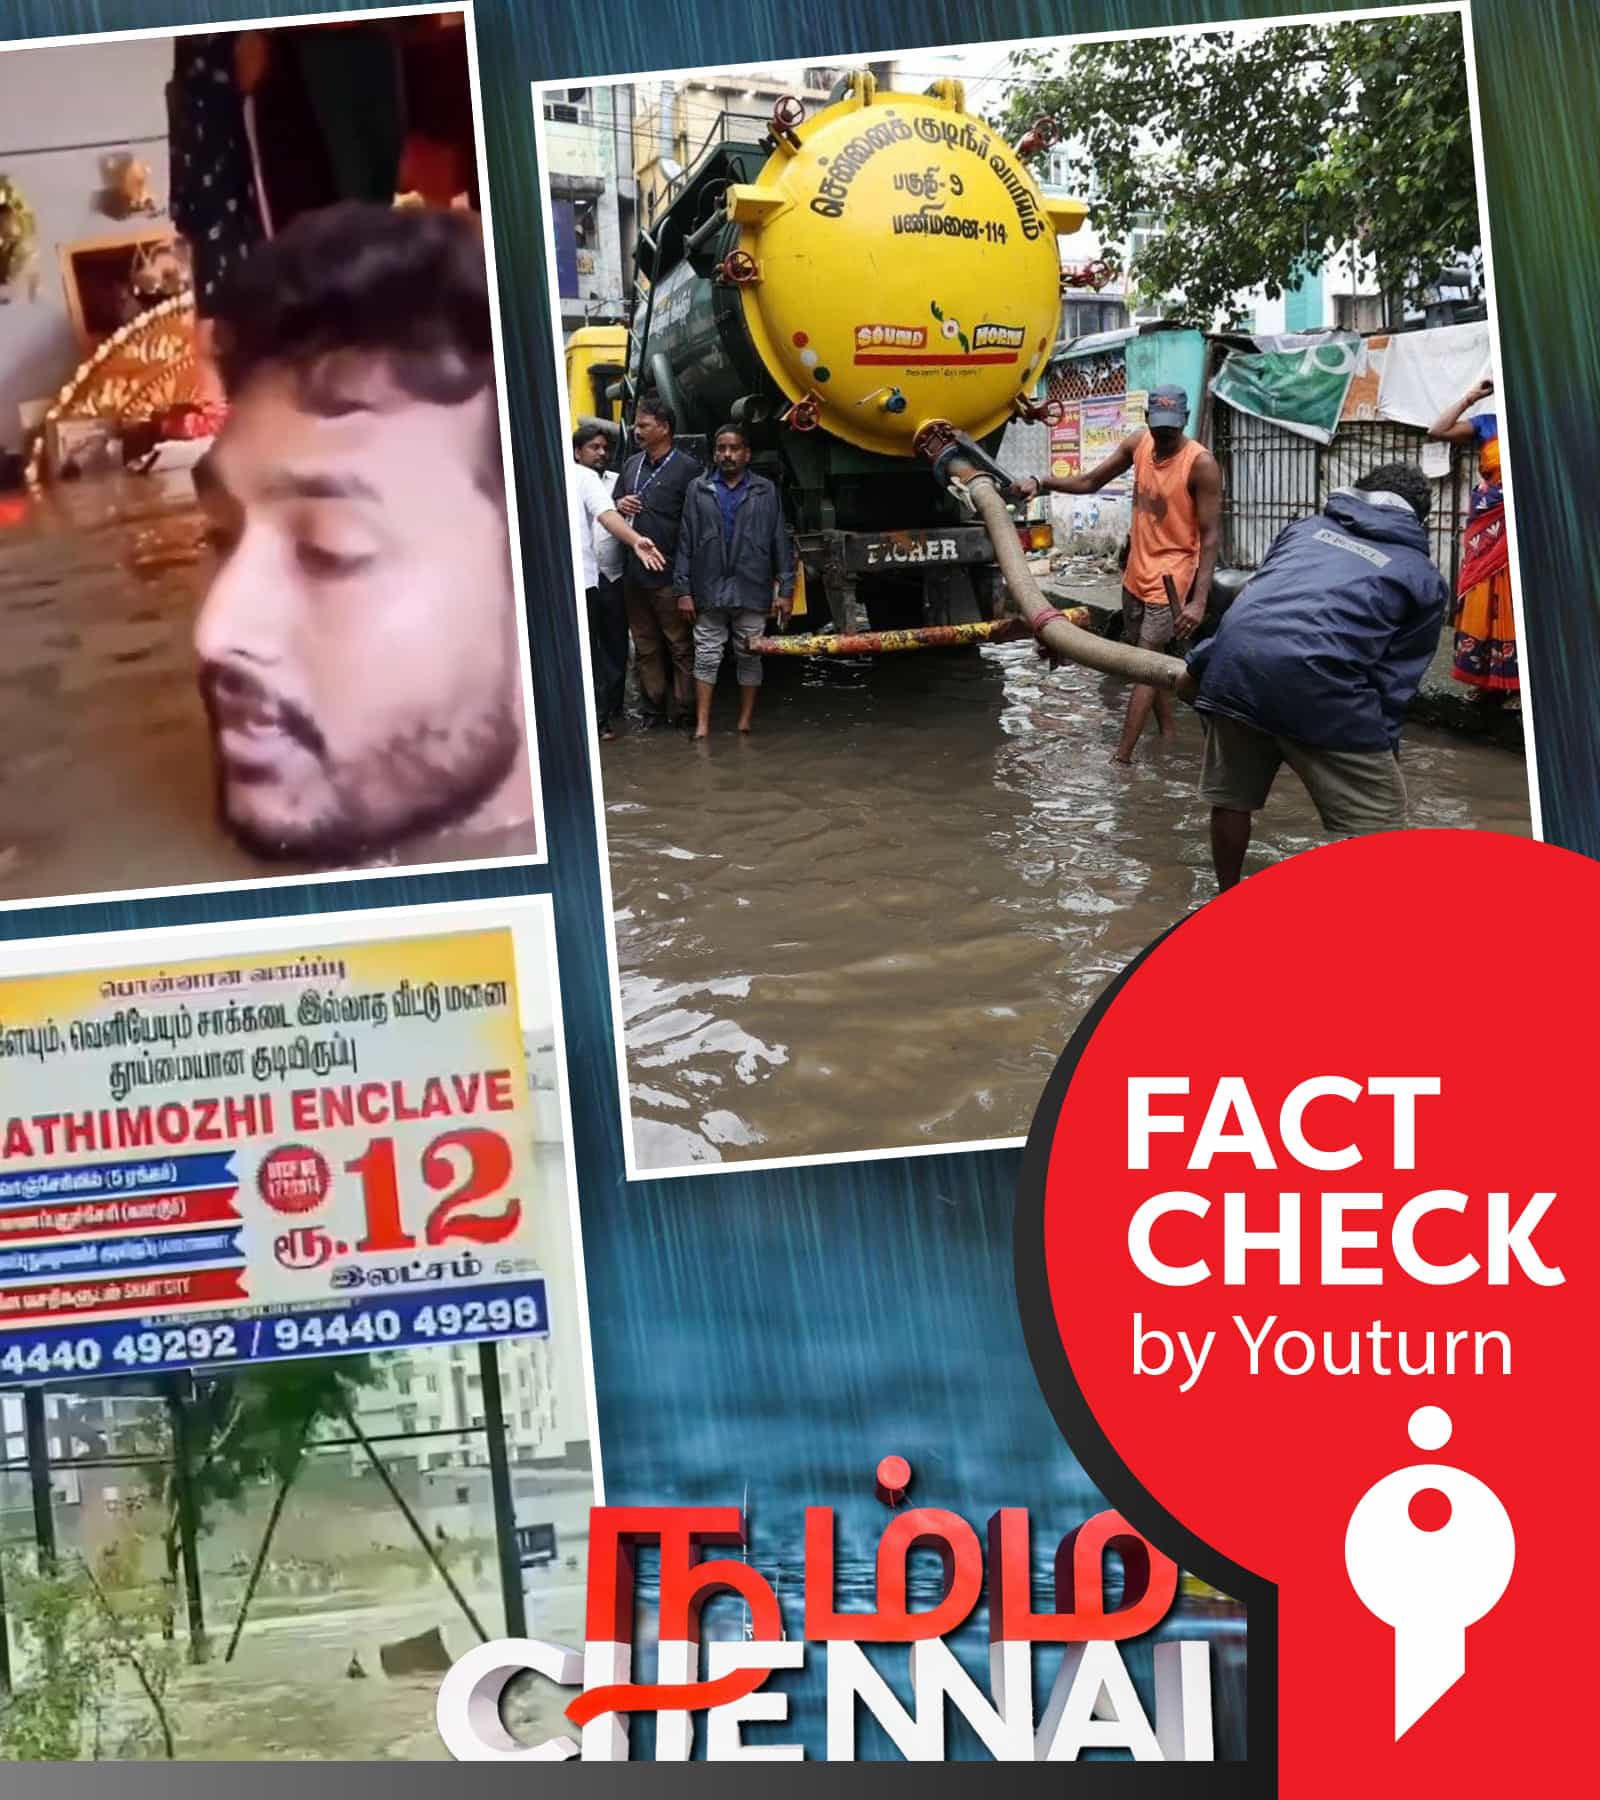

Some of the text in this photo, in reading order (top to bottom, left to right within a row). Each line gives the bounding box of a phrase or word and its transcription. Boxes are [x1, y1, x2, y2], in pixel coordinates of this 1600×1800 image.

[913, 115, 992, 160] குடிநீர்
[989, 154, 1045, 240] வாரியம்
[197, 999, 293, 1038] சாக்கடை
[297, 988, 388, 1028] இல்லாத
[292, 1069, 515, 1132] ENCLAVE
[112, 1323, 238, 1365] 49292
[274, 1309, 400, 1351] 94440
[413, 1296, 538, 1337] 49298
